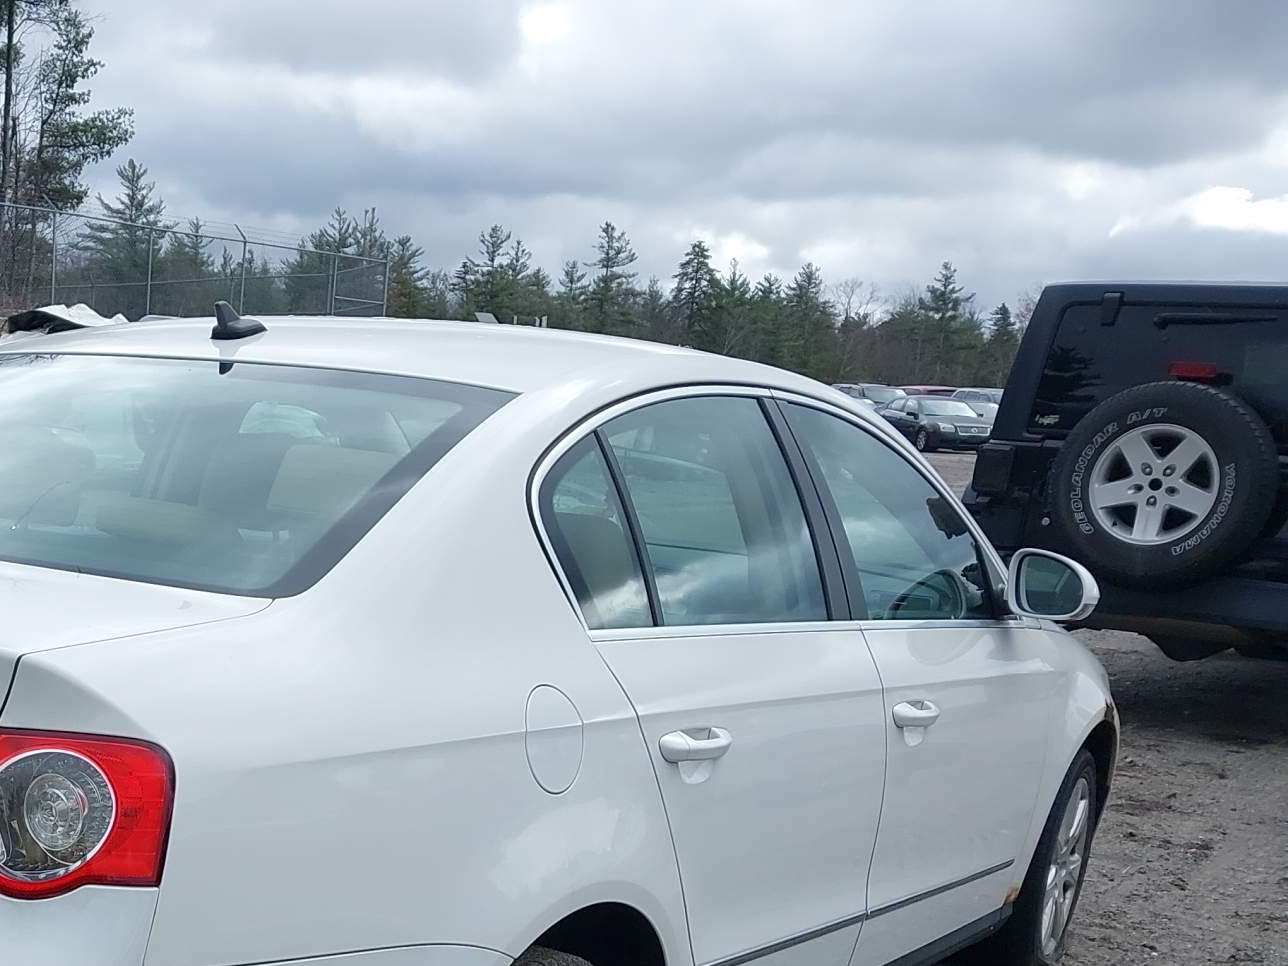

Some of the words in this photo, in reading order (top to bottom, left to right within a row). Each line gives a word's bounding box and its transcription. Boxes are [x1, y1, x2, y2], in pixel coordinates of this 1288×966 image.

[1070, 422, 1119, 534] GEOLANDAR
[1127, 407, 1168, 425] A/T
[1171, 463, 1236, 556] YOKOHAMA
